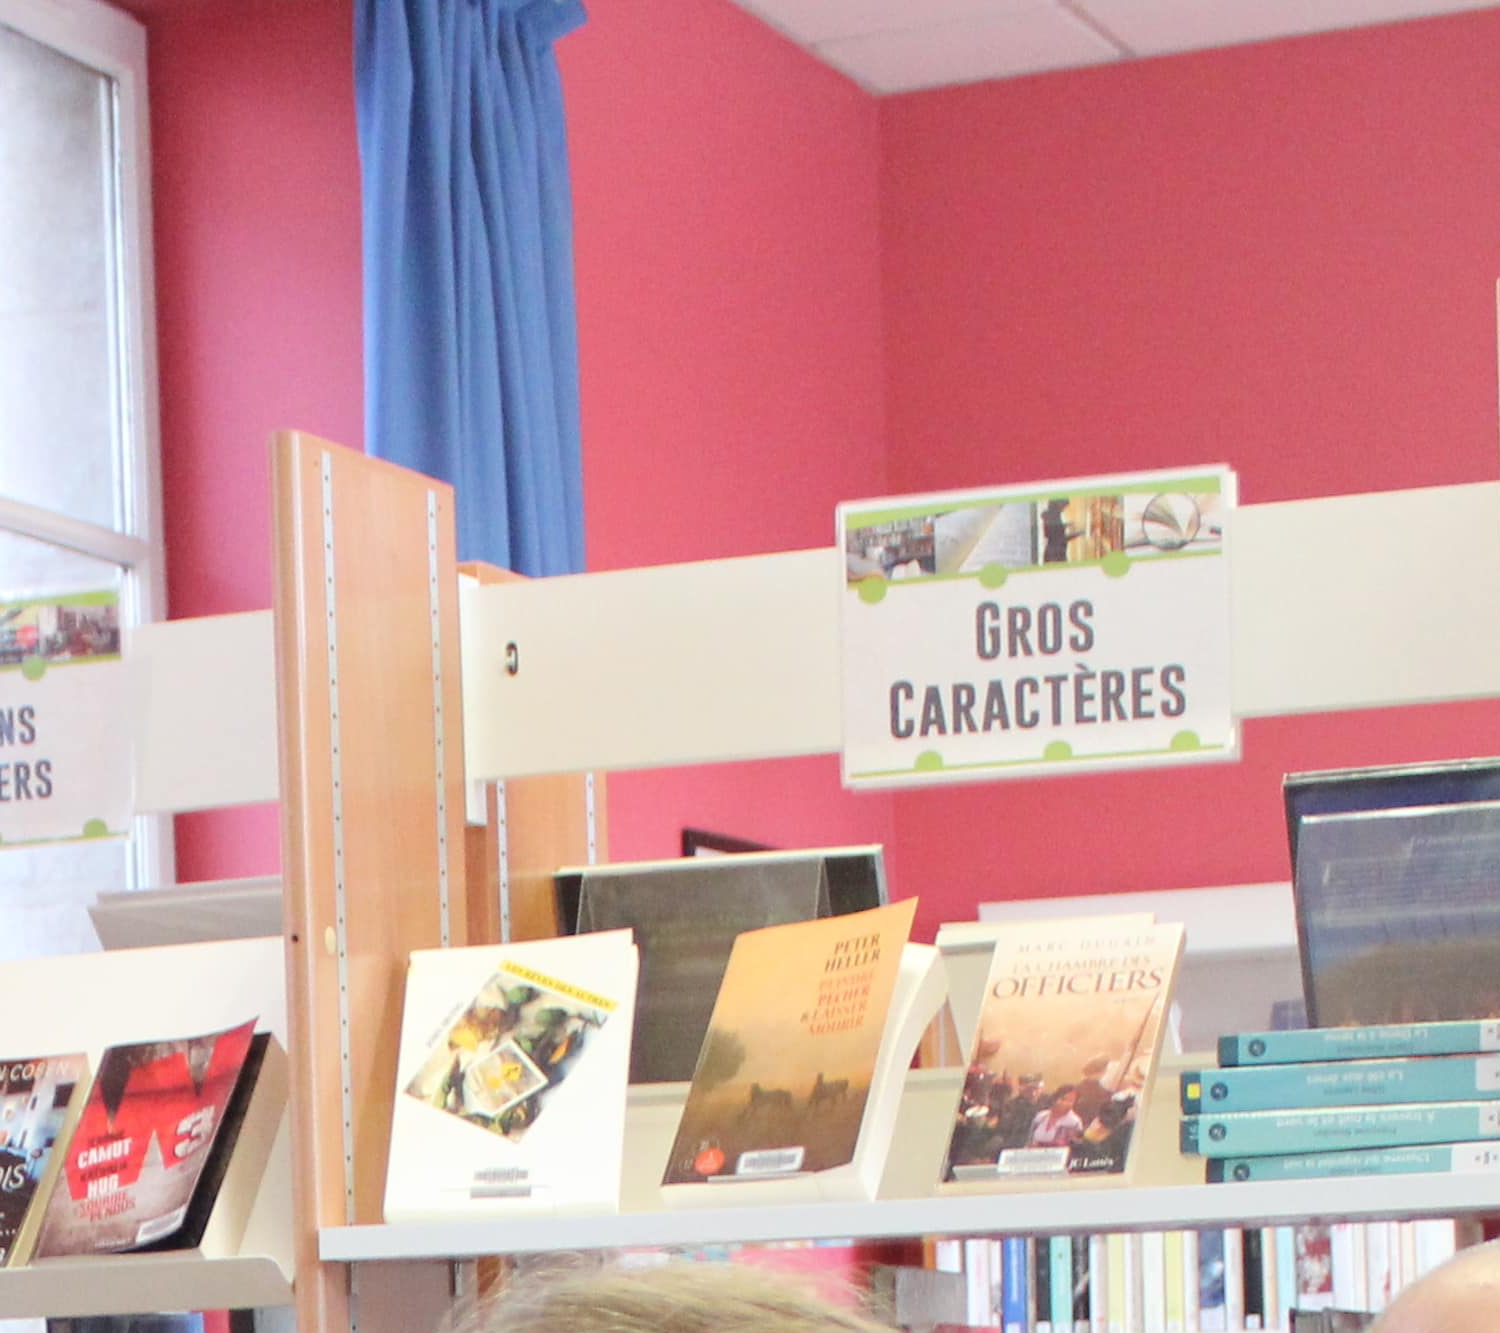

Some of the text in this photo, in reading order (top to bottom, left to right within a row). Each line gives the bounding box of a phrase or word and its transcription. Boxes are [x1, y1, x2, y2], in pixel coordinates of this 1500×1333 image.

[975, 600, 1095, 661] GROS
[889, 663, 1187, 740] CARACTÈRES
[993, 969, 1162, 999] OFFICIERS
[77, 1137, 133, 1169] CAMUT
